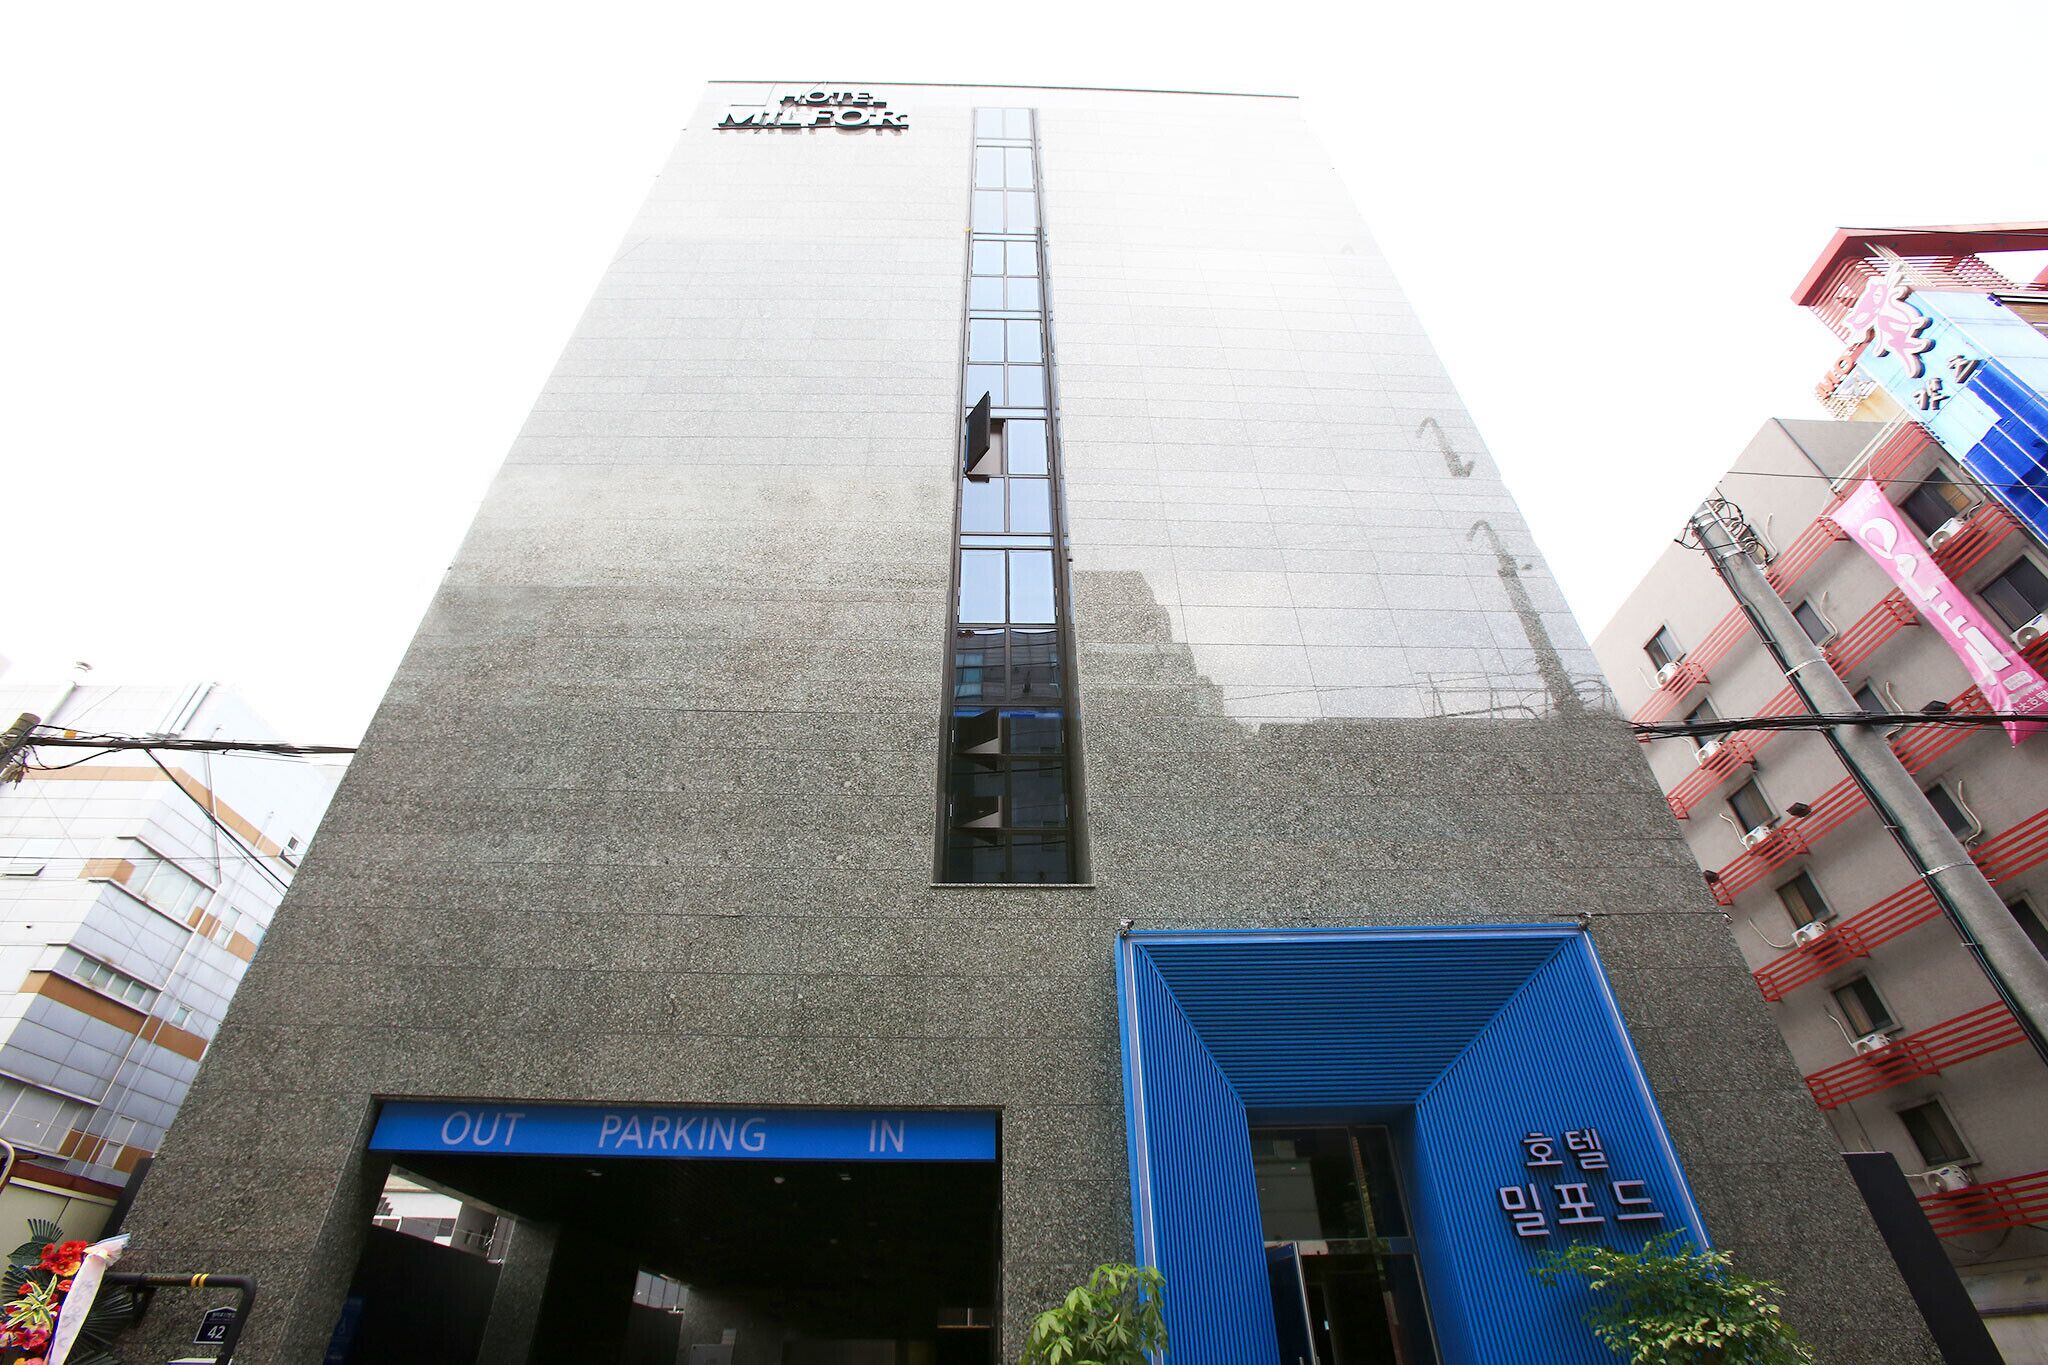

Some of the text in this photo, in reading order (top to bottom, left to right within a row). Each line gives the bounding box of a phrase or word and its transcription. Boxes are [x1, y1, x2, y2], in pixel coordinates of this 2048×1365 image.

[779, 89, 887, 108] HOTEL
[439, 1111, 906, 1154] OUT PARKING IN
[1522, 1126, 1610, 1171] 호텔
[1498, 1178, 1665, 1237] 밀포드
[207, 1325, 227, 1339] 42
